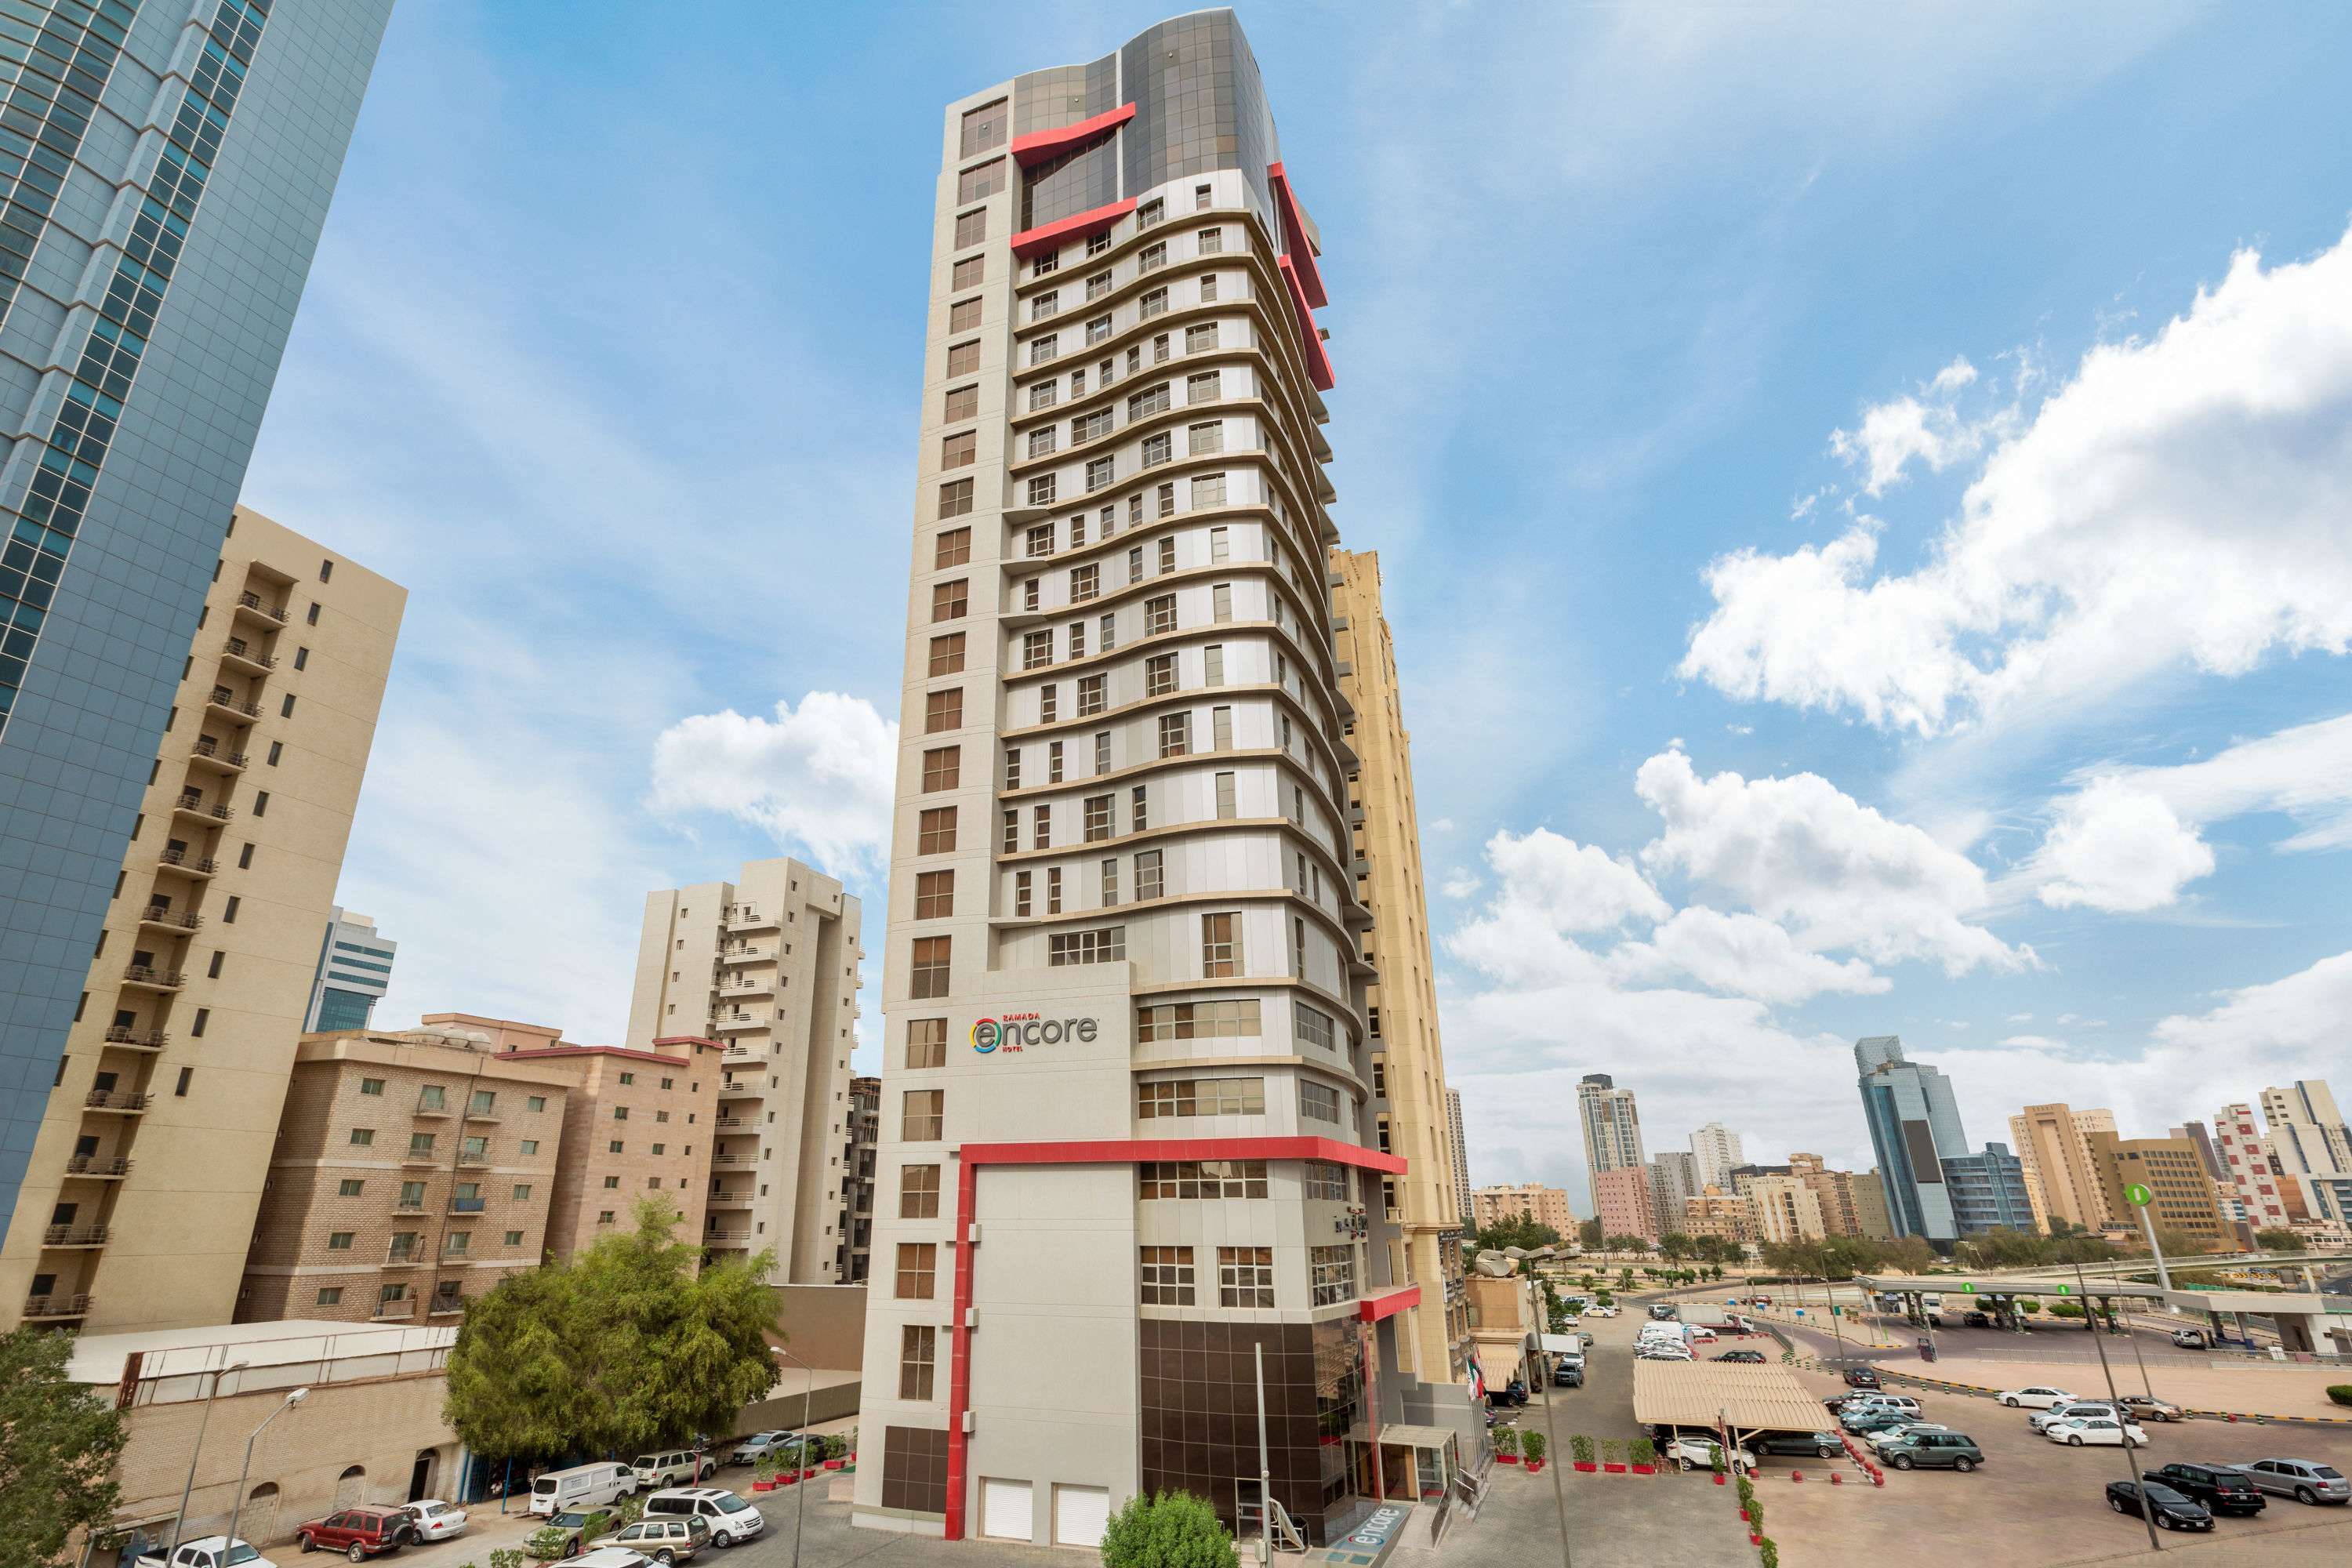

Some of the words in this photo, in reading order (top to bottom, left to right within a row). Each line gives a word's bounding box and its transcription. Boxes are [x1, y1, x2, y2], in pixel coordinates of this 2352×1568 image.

[975, 1017, 1098, 1047] encore
[1003, 1012, 1040, 1022] RAMADA
[1355, 1508, 1400, 1544] encore
